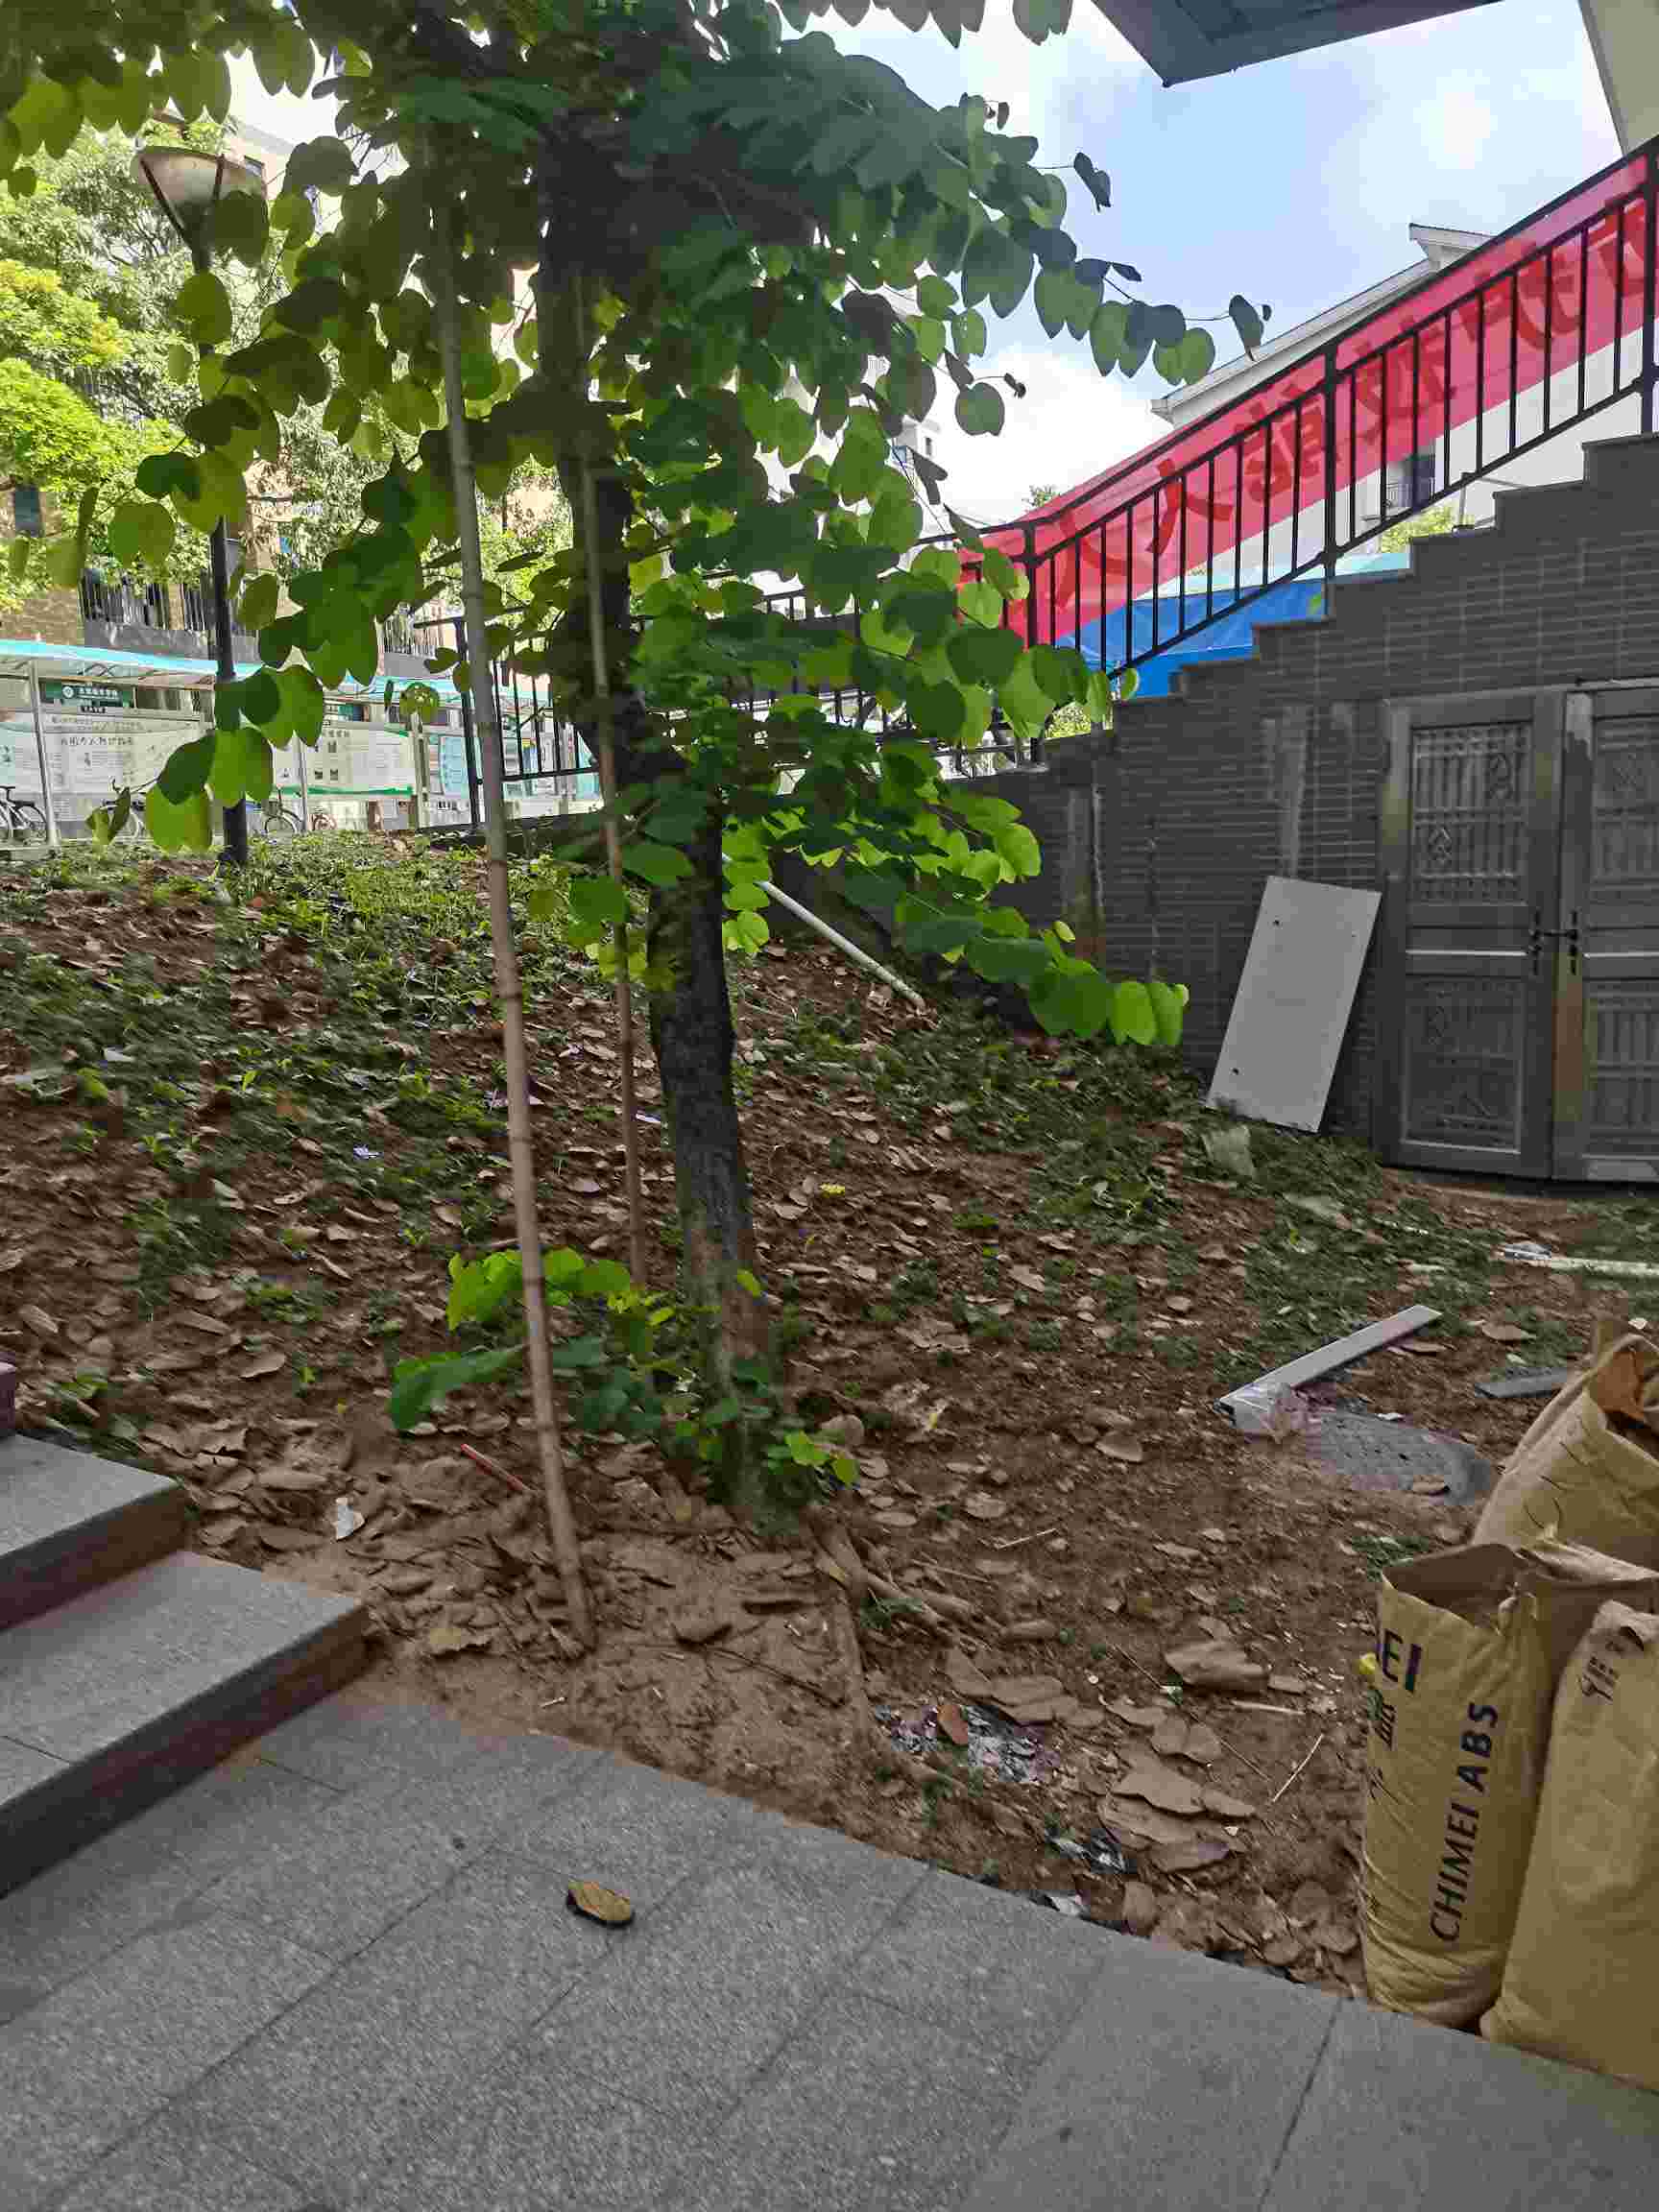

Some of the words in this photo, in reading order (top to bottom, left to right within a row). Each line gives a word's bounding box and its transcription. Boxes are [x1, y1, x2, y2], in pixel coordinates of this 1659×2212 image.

[1379, 1627, 1422, 1694] EI
[1430, 1801, 1479, 1941] CHIMEI
[1456, 1702, 1499, 1793] ABS
